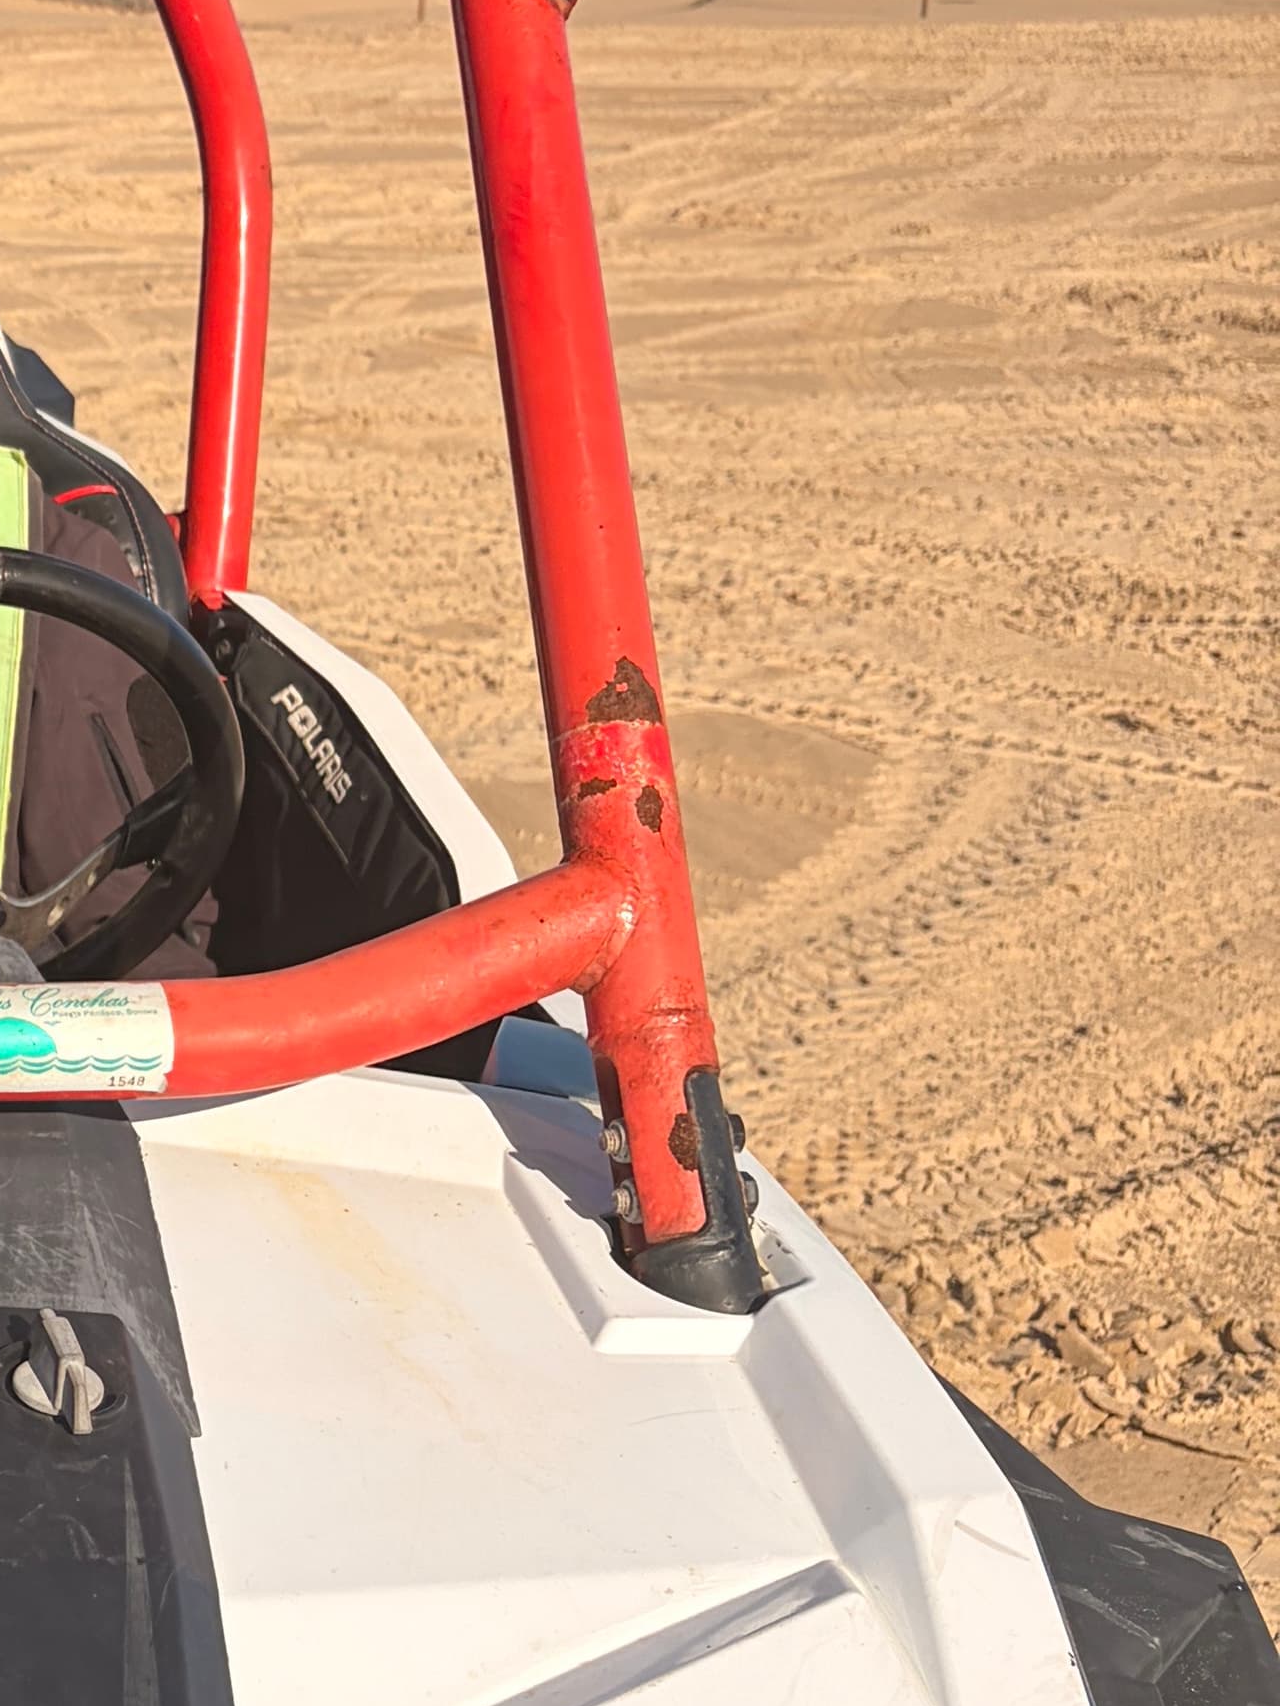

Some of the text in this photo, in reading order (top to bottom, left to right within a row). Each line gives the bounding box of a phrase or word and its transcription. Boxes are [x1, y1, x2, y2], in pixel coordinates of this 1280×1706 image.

[270, 683, 353, 805] POLARIS
[21, 986, 130, 1017] Conchas
[106, 1075, 146, 1087] 1548
